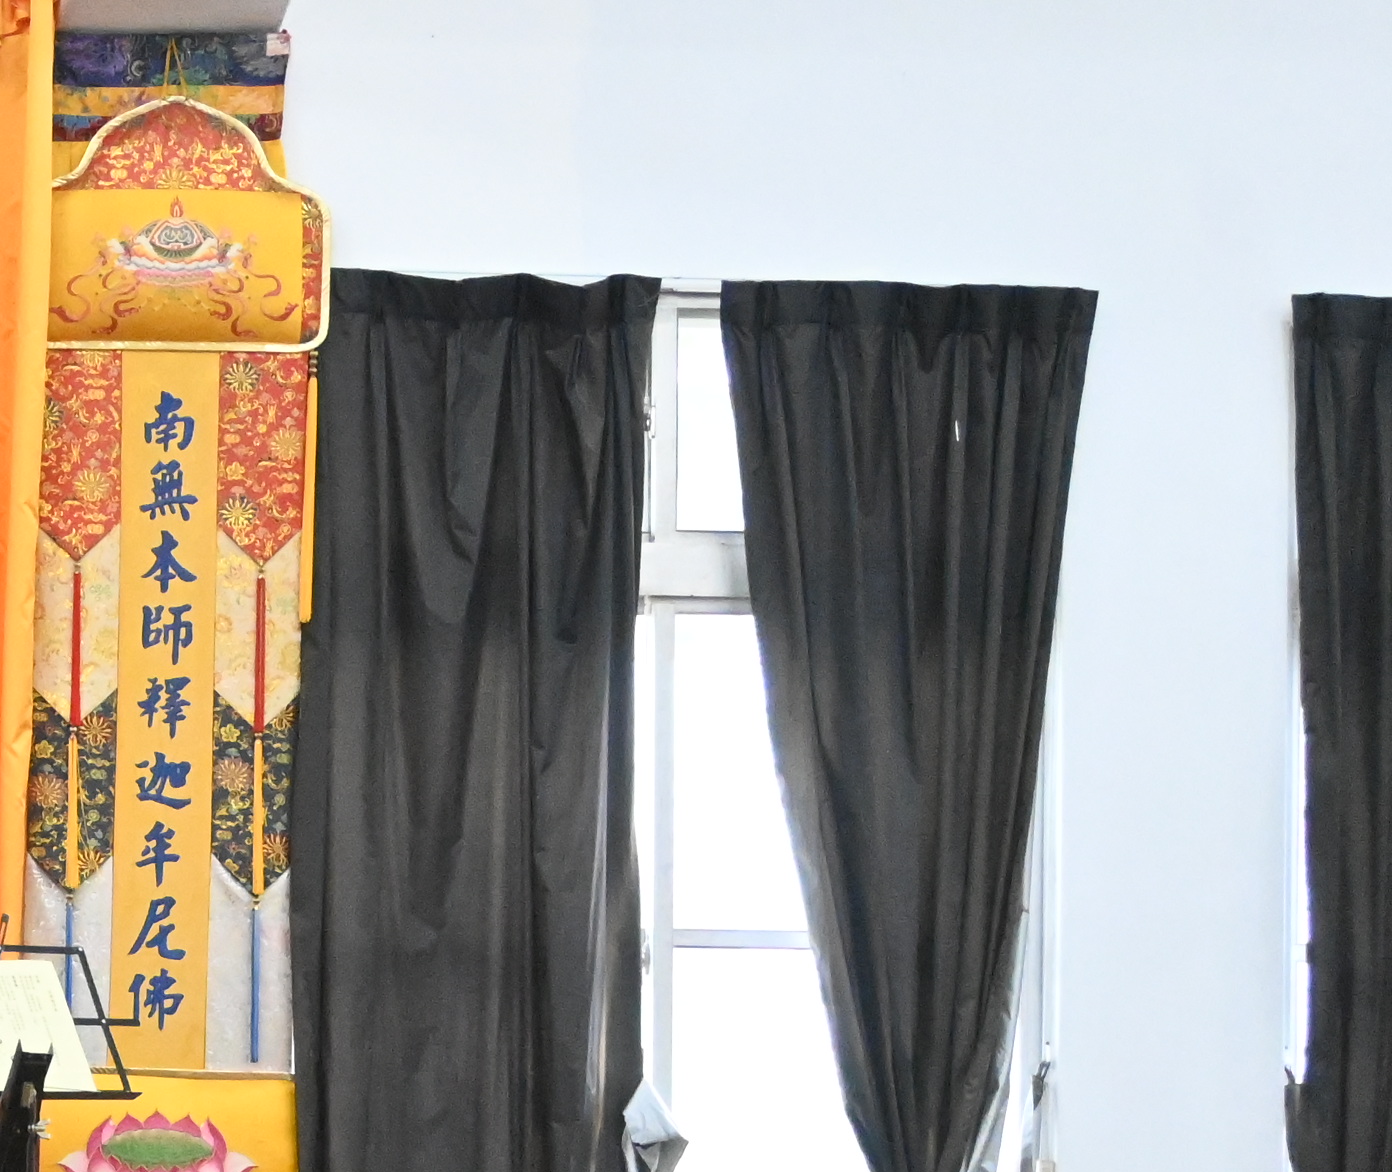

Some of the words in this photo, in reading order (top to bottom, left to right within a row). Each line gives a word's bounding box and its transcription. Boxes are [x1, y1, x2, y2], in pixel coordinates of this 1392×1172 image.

[127, 391, 198, 1031] 南無本師釋迦牟尼佛
